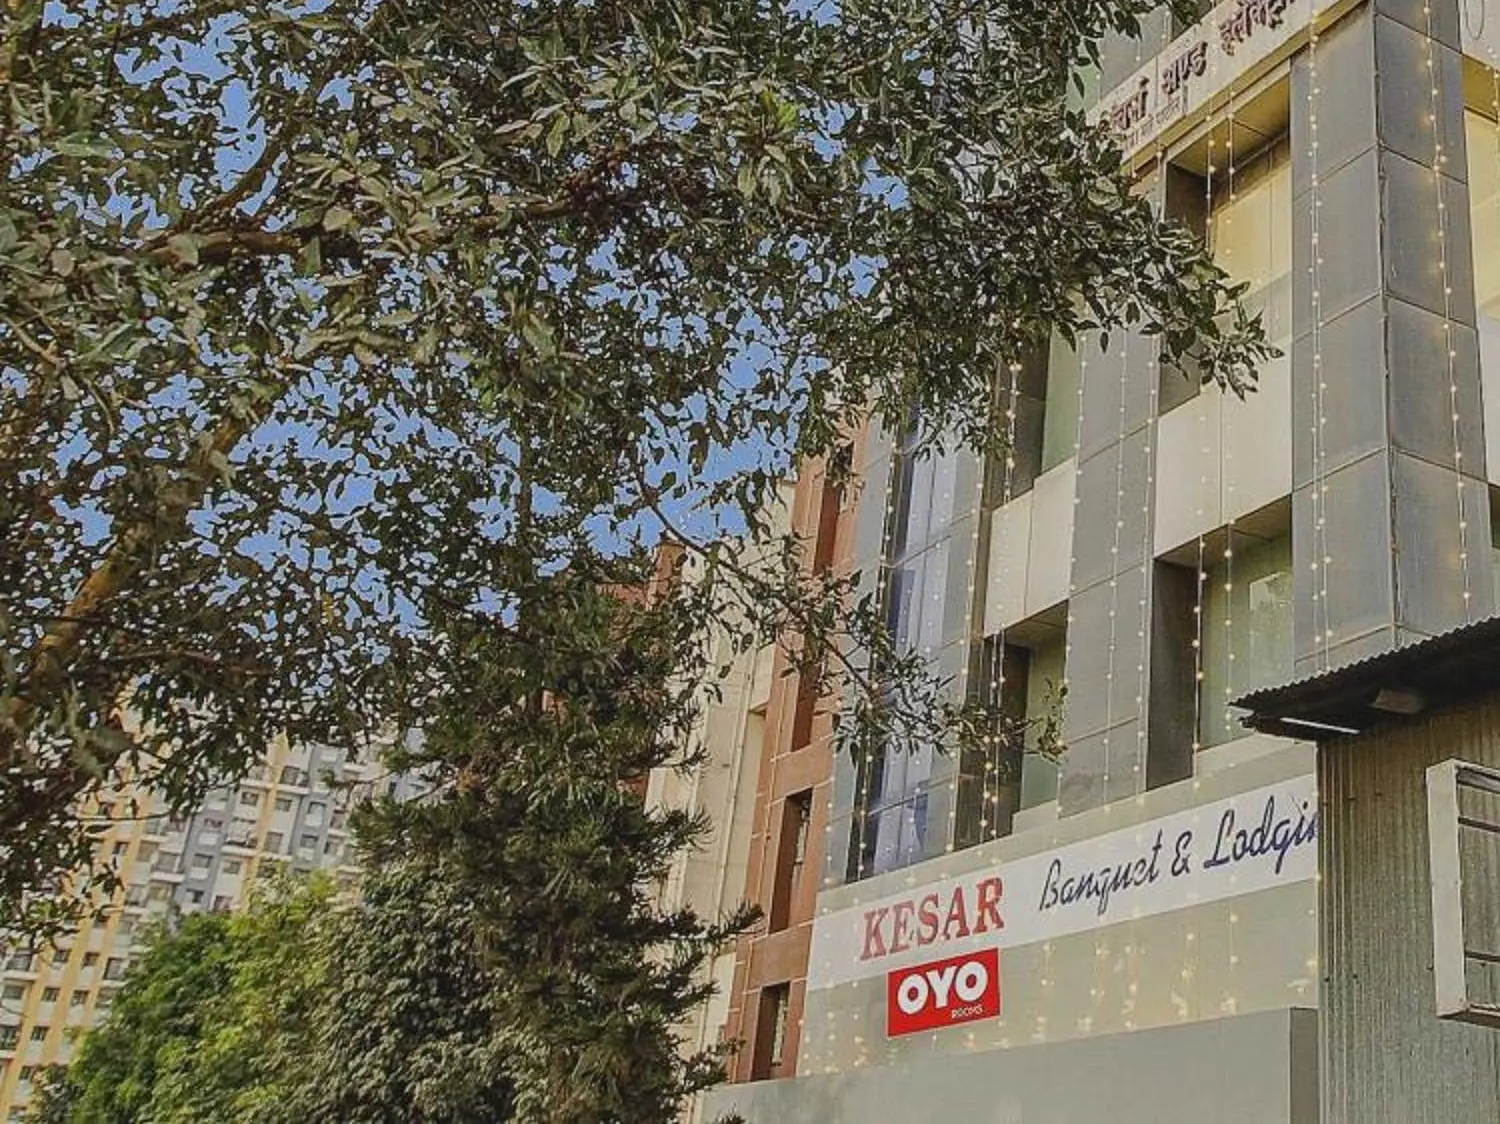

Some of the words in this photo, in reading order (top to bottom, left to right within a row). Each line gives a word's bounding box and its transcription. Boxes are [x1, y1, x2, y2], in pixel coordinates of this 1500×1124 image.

[859, 875, 1006, 962] KESAR
[1038, 829, 1164, 917] Banquet
[1170, 829, 1192, 876] &
[1203, 795, 1319, 875] Lodgin
[896, 960, 989, 1015] OYO
